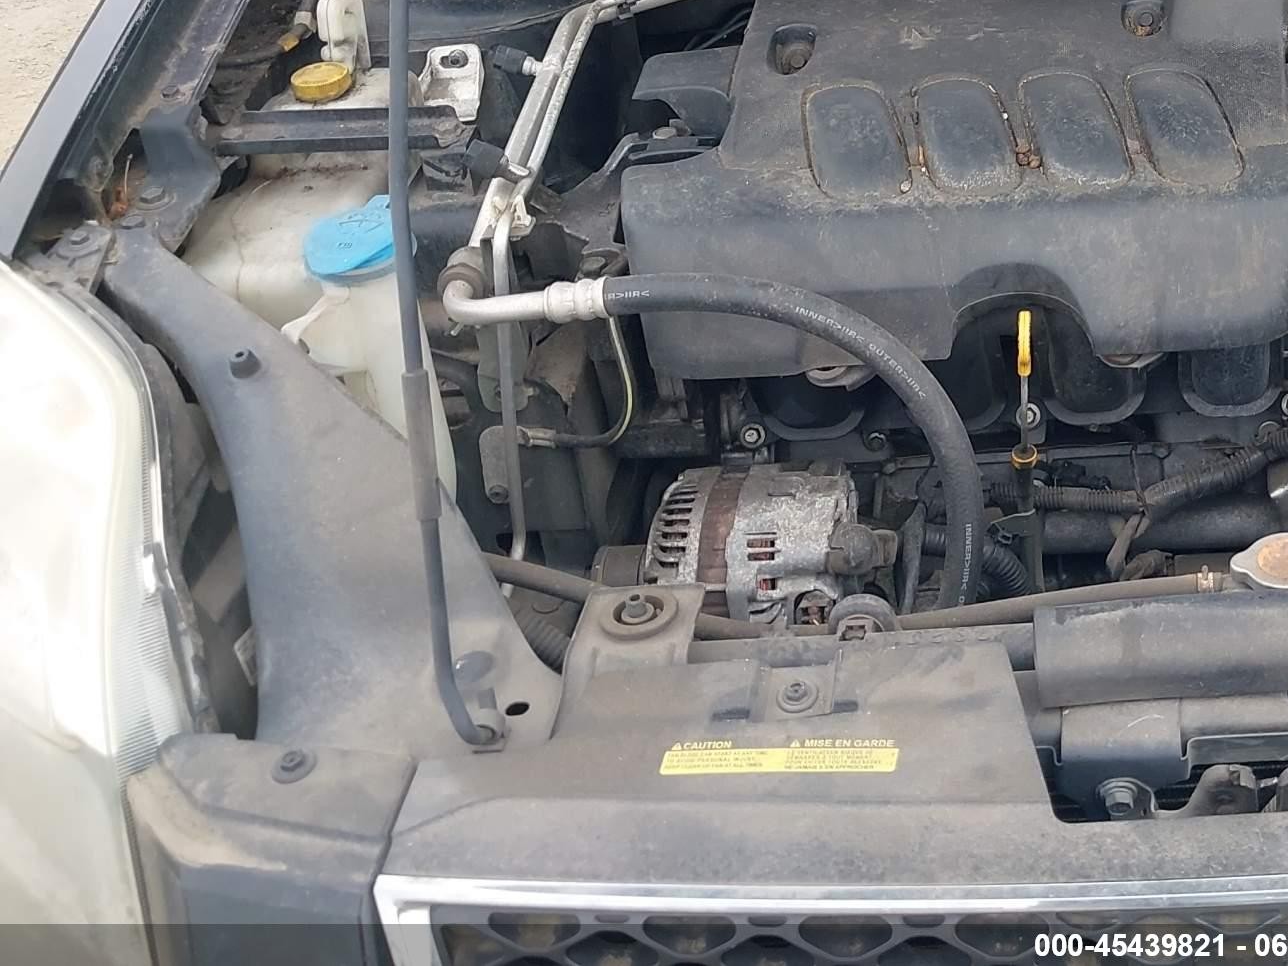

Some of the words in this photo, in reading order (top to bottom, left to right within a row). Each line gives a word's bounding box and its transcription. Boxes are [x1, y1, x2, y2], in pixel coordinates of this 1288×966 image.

[683, 740, 732, 750] CAUTION
[804, 739, 833, 747] MISE
[834, 739, 852, 747] EN
[853, 739, 896, 747] GARDE
